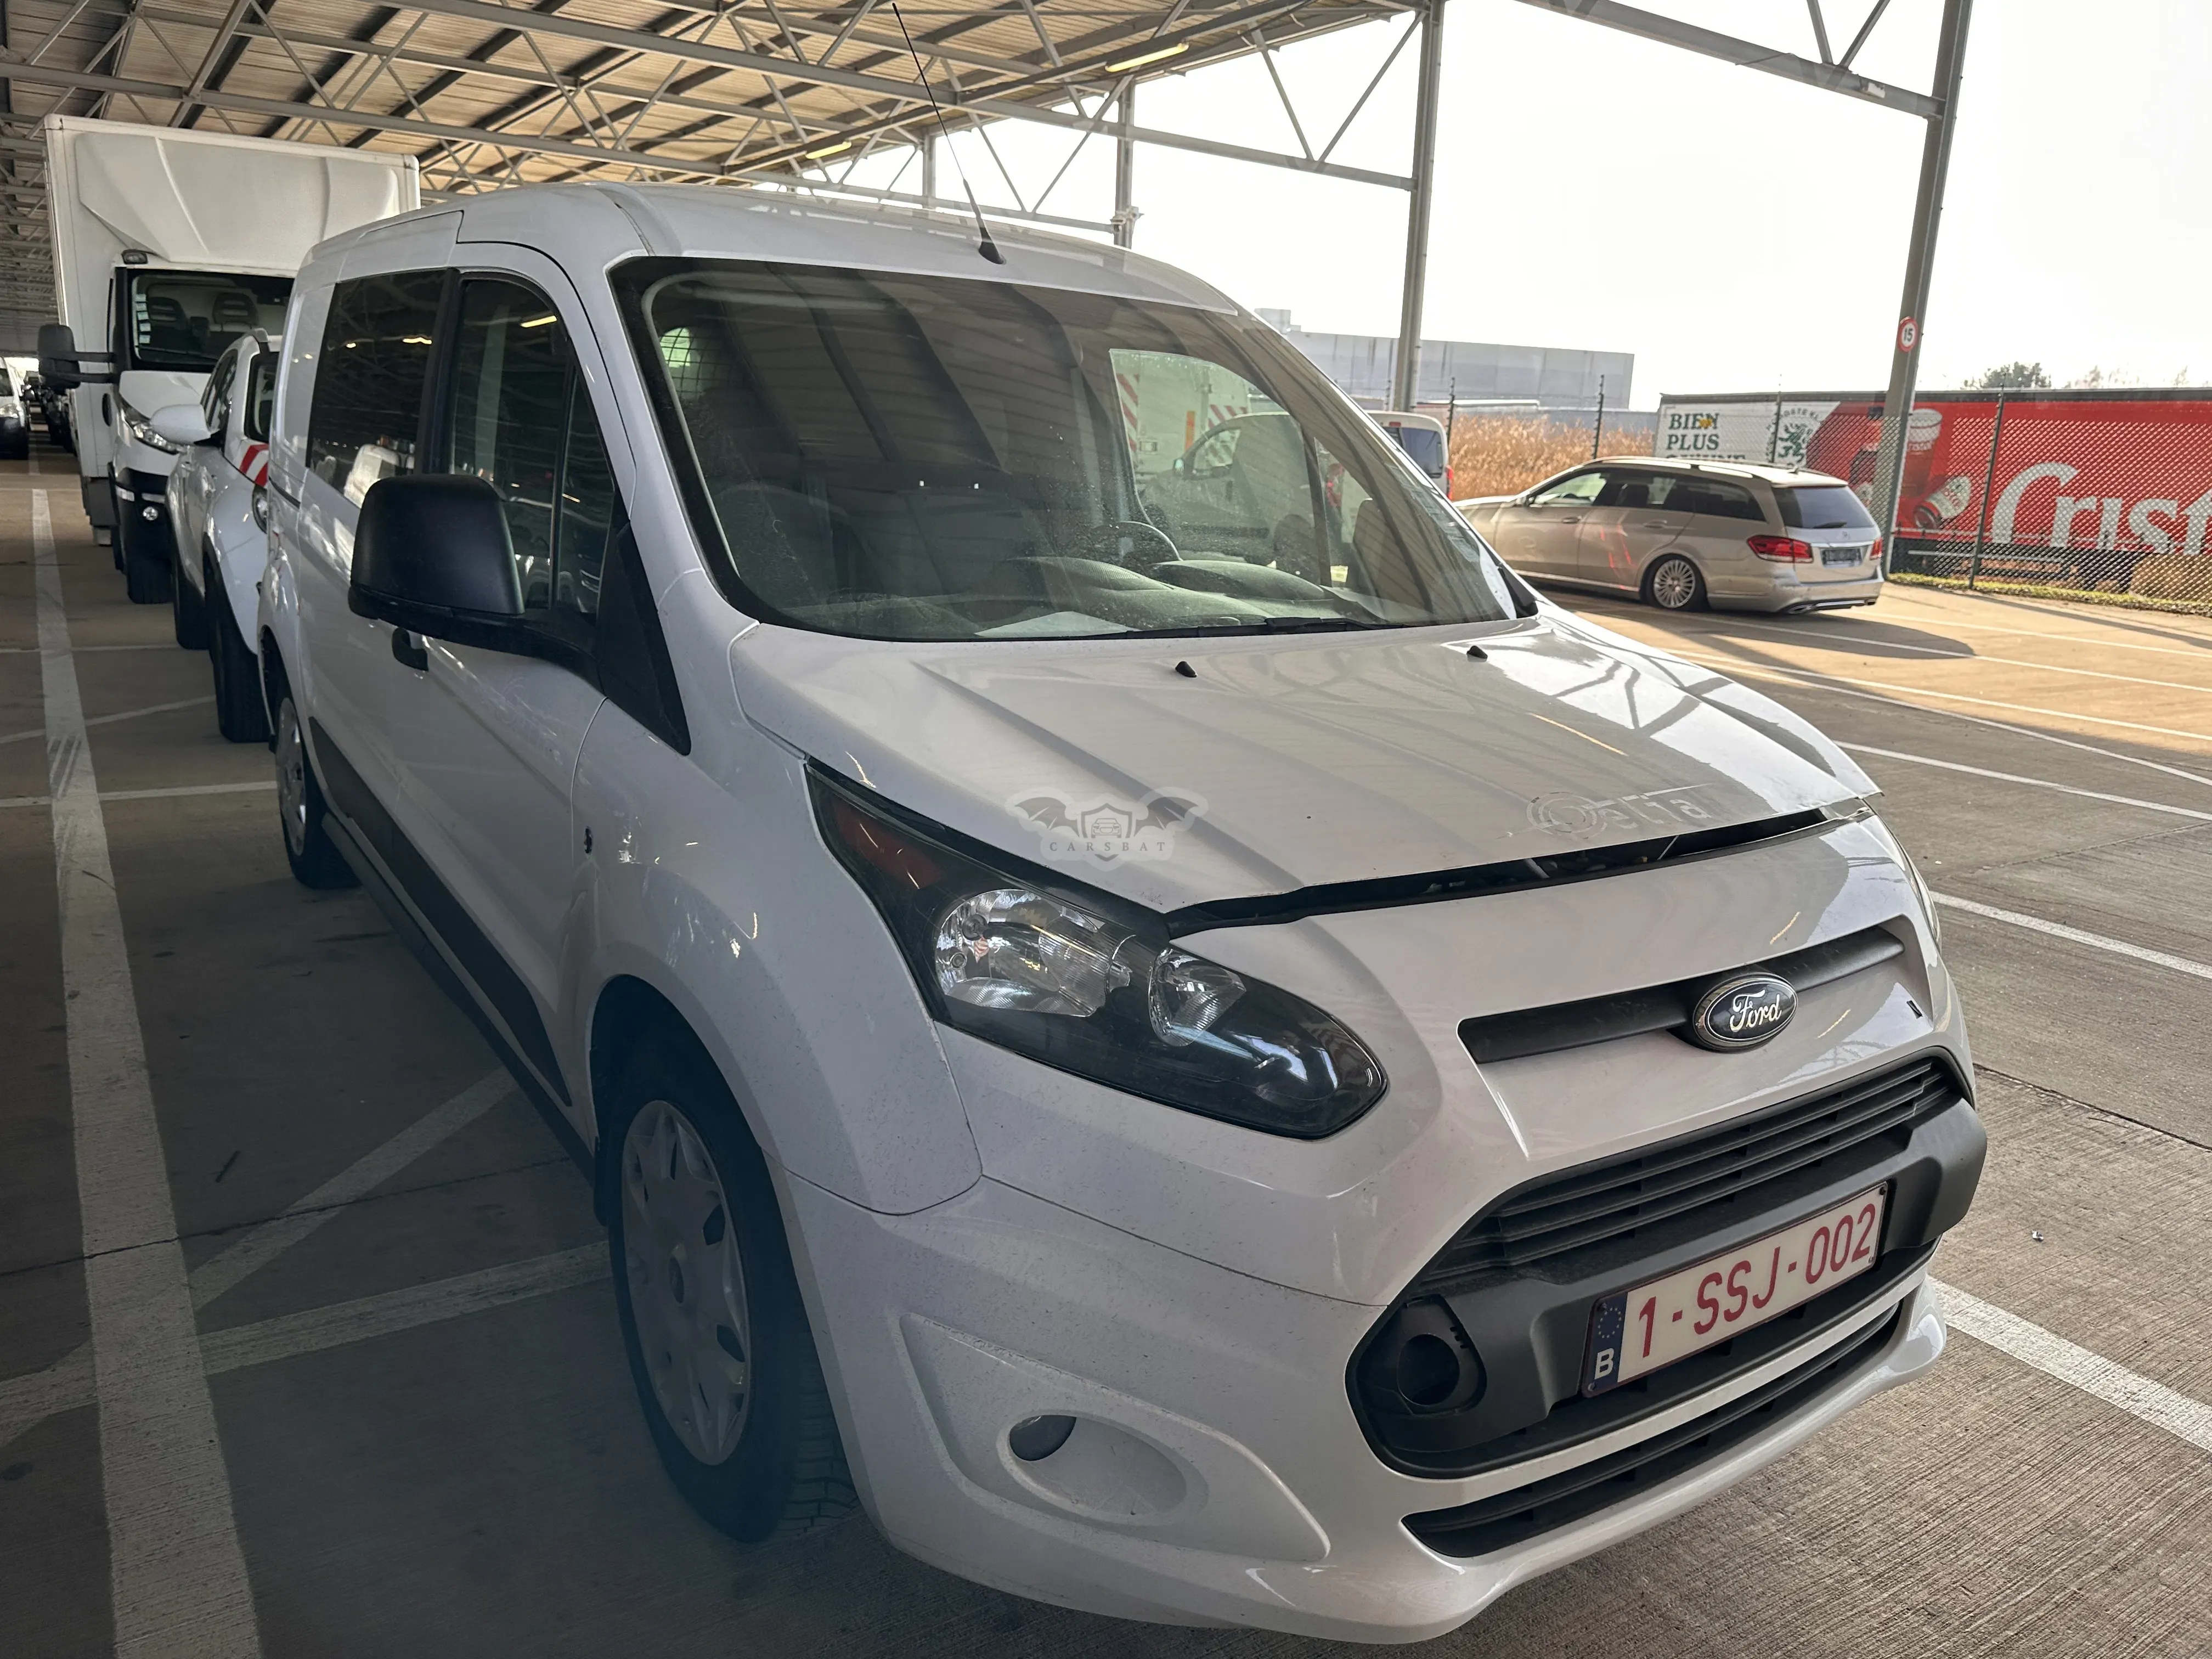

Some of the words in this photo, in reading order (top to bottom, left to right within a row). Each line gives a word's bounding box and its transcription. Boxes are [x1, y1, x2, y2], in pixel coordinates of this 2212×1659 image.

[1904, 328, 1913, 342] 15
[1668, 413, 1720, 430] BIEN
[1666, 433, 1719, 450] PLUS
[1729, 989, 1782, 1032] Ford
[1638, 1203, 1876, 1359] 1-SSJ-002
[1594, 1347, 1615, 1380] B
